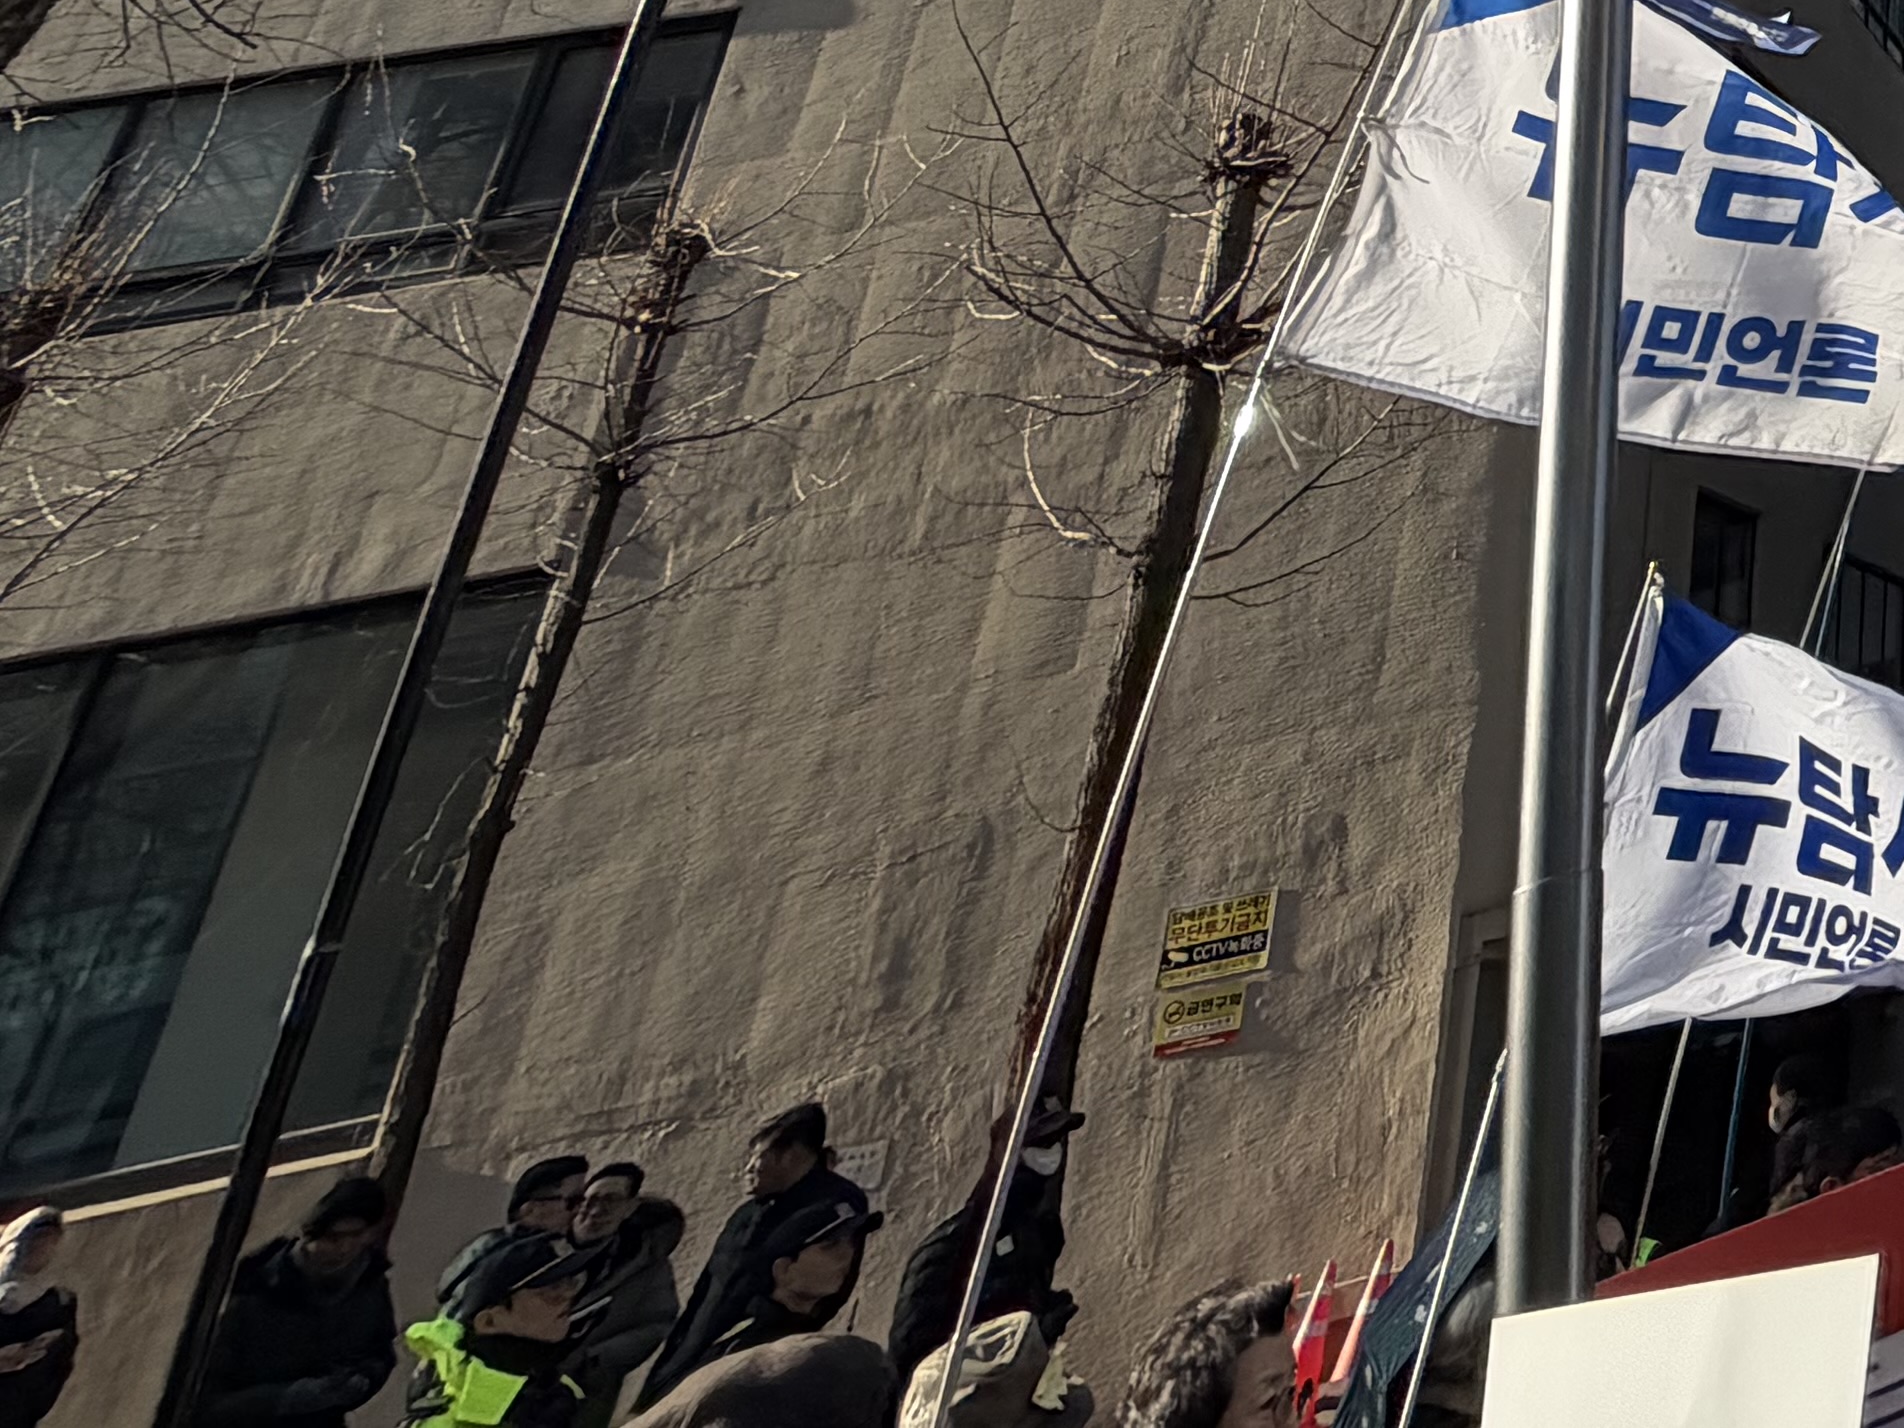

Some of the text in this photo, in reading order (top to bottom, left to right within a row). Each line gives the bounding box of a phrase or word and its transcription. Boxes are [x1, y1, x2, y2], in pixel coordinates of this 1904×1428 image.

[1168, 910, 1269, 944] 무단투기금지
[1710, 882, 1902, 972] 시민언론
[1185, 992, 1242, 1017] 금연구역
